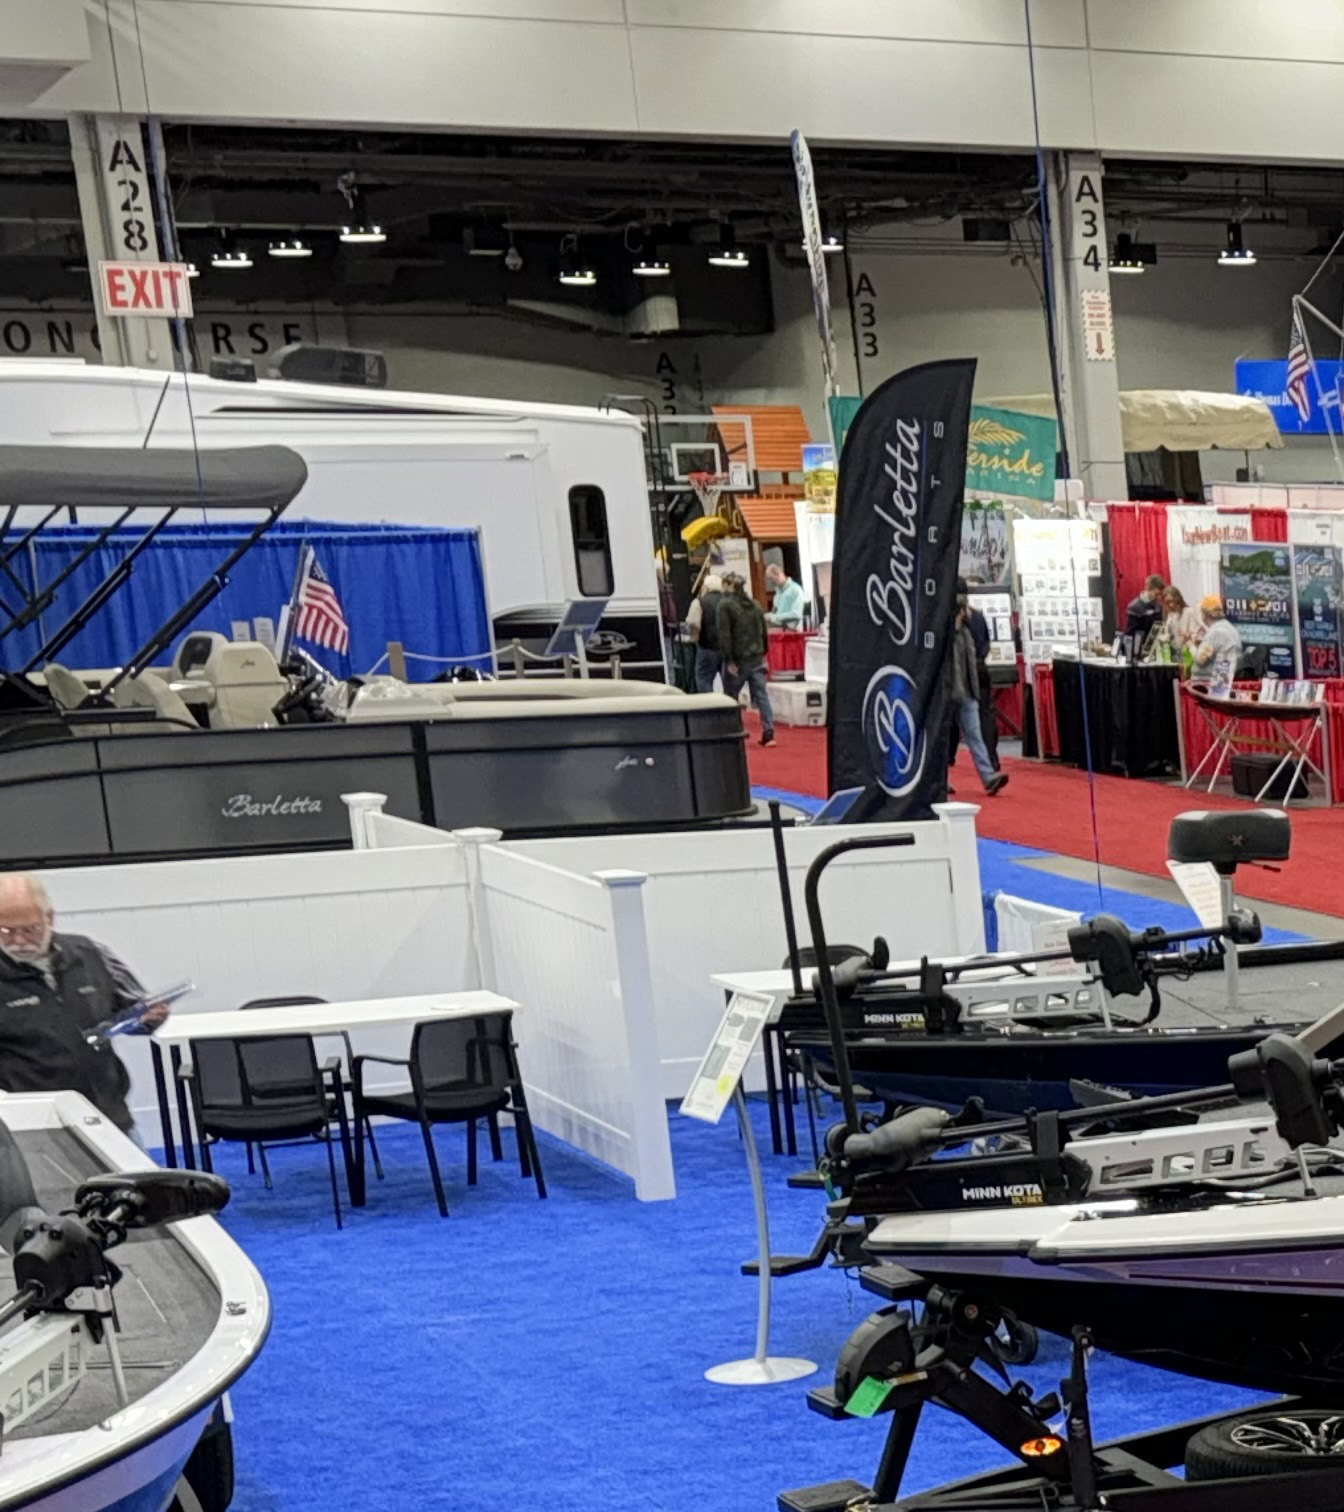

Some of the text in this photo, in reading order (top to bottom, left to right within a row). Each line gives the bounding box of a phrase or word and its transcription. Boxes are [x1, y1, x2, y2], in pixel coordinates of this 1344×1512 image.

[105, 268, 182, 310] EXIT
[866, 416, 921, 647] Barletta
[923, 419, 944, 650] BOATS
[221, 793, 324, 818] Barletta
[864, 1013, 894, 1024] MINN
[961, 1183, 1043, 1201] MINN KOTA
